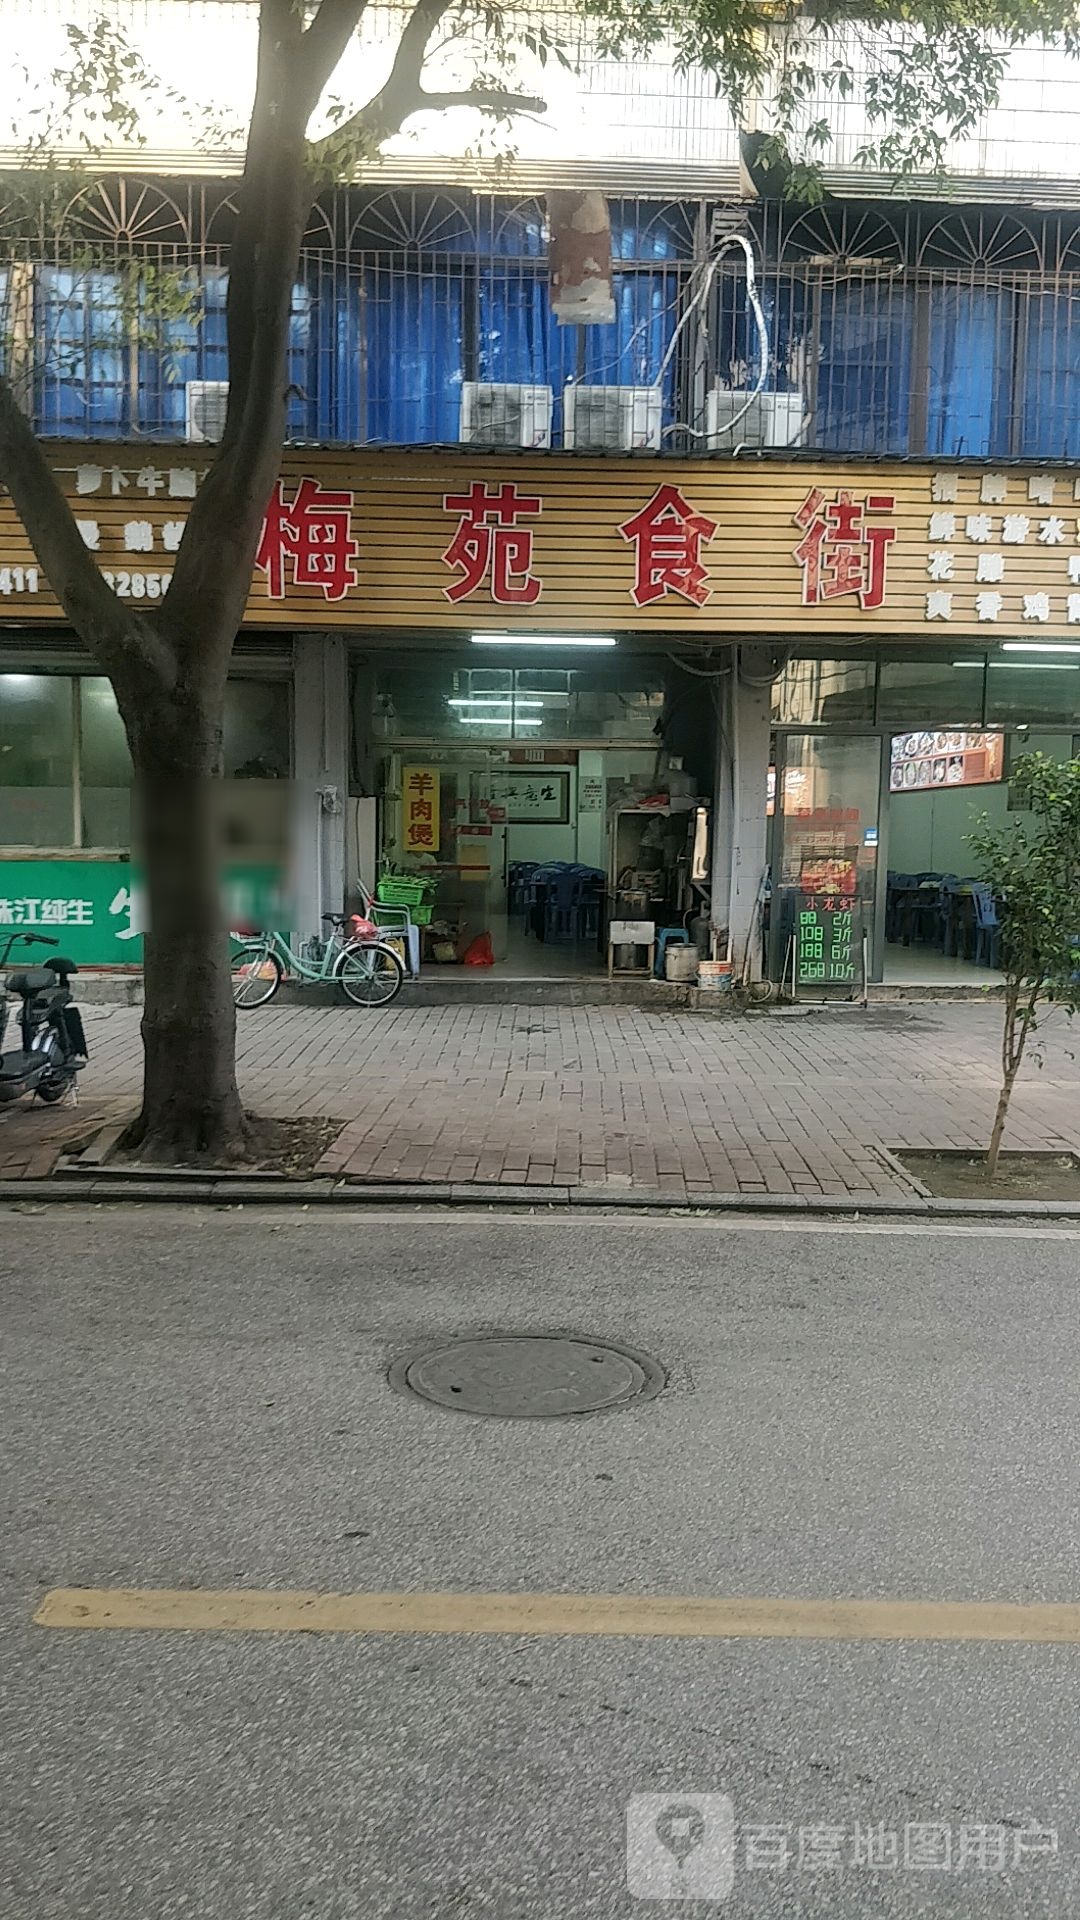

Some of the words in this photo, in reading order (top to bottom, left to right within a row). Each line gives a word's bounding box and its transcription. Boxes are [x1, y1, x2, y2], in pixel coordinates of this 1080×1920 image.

[255, 477, 898, 611] 梅苑食街
[408, 772, 434, 847] 羊肉煲
[806, 896, 856, 912] 小龙虾
[800, 911, 817, 925] 88
[832, 910, 852, 926] 2斤
[800, 926, 823, 941] 108
[832, 927, 853, 943] 3斤
[800, 943, 824, 959] 188
[831, 944, 852, 960] 6斤
[800, 961, 825, 978] 268
[829, 963, 855, 979] 10斤
